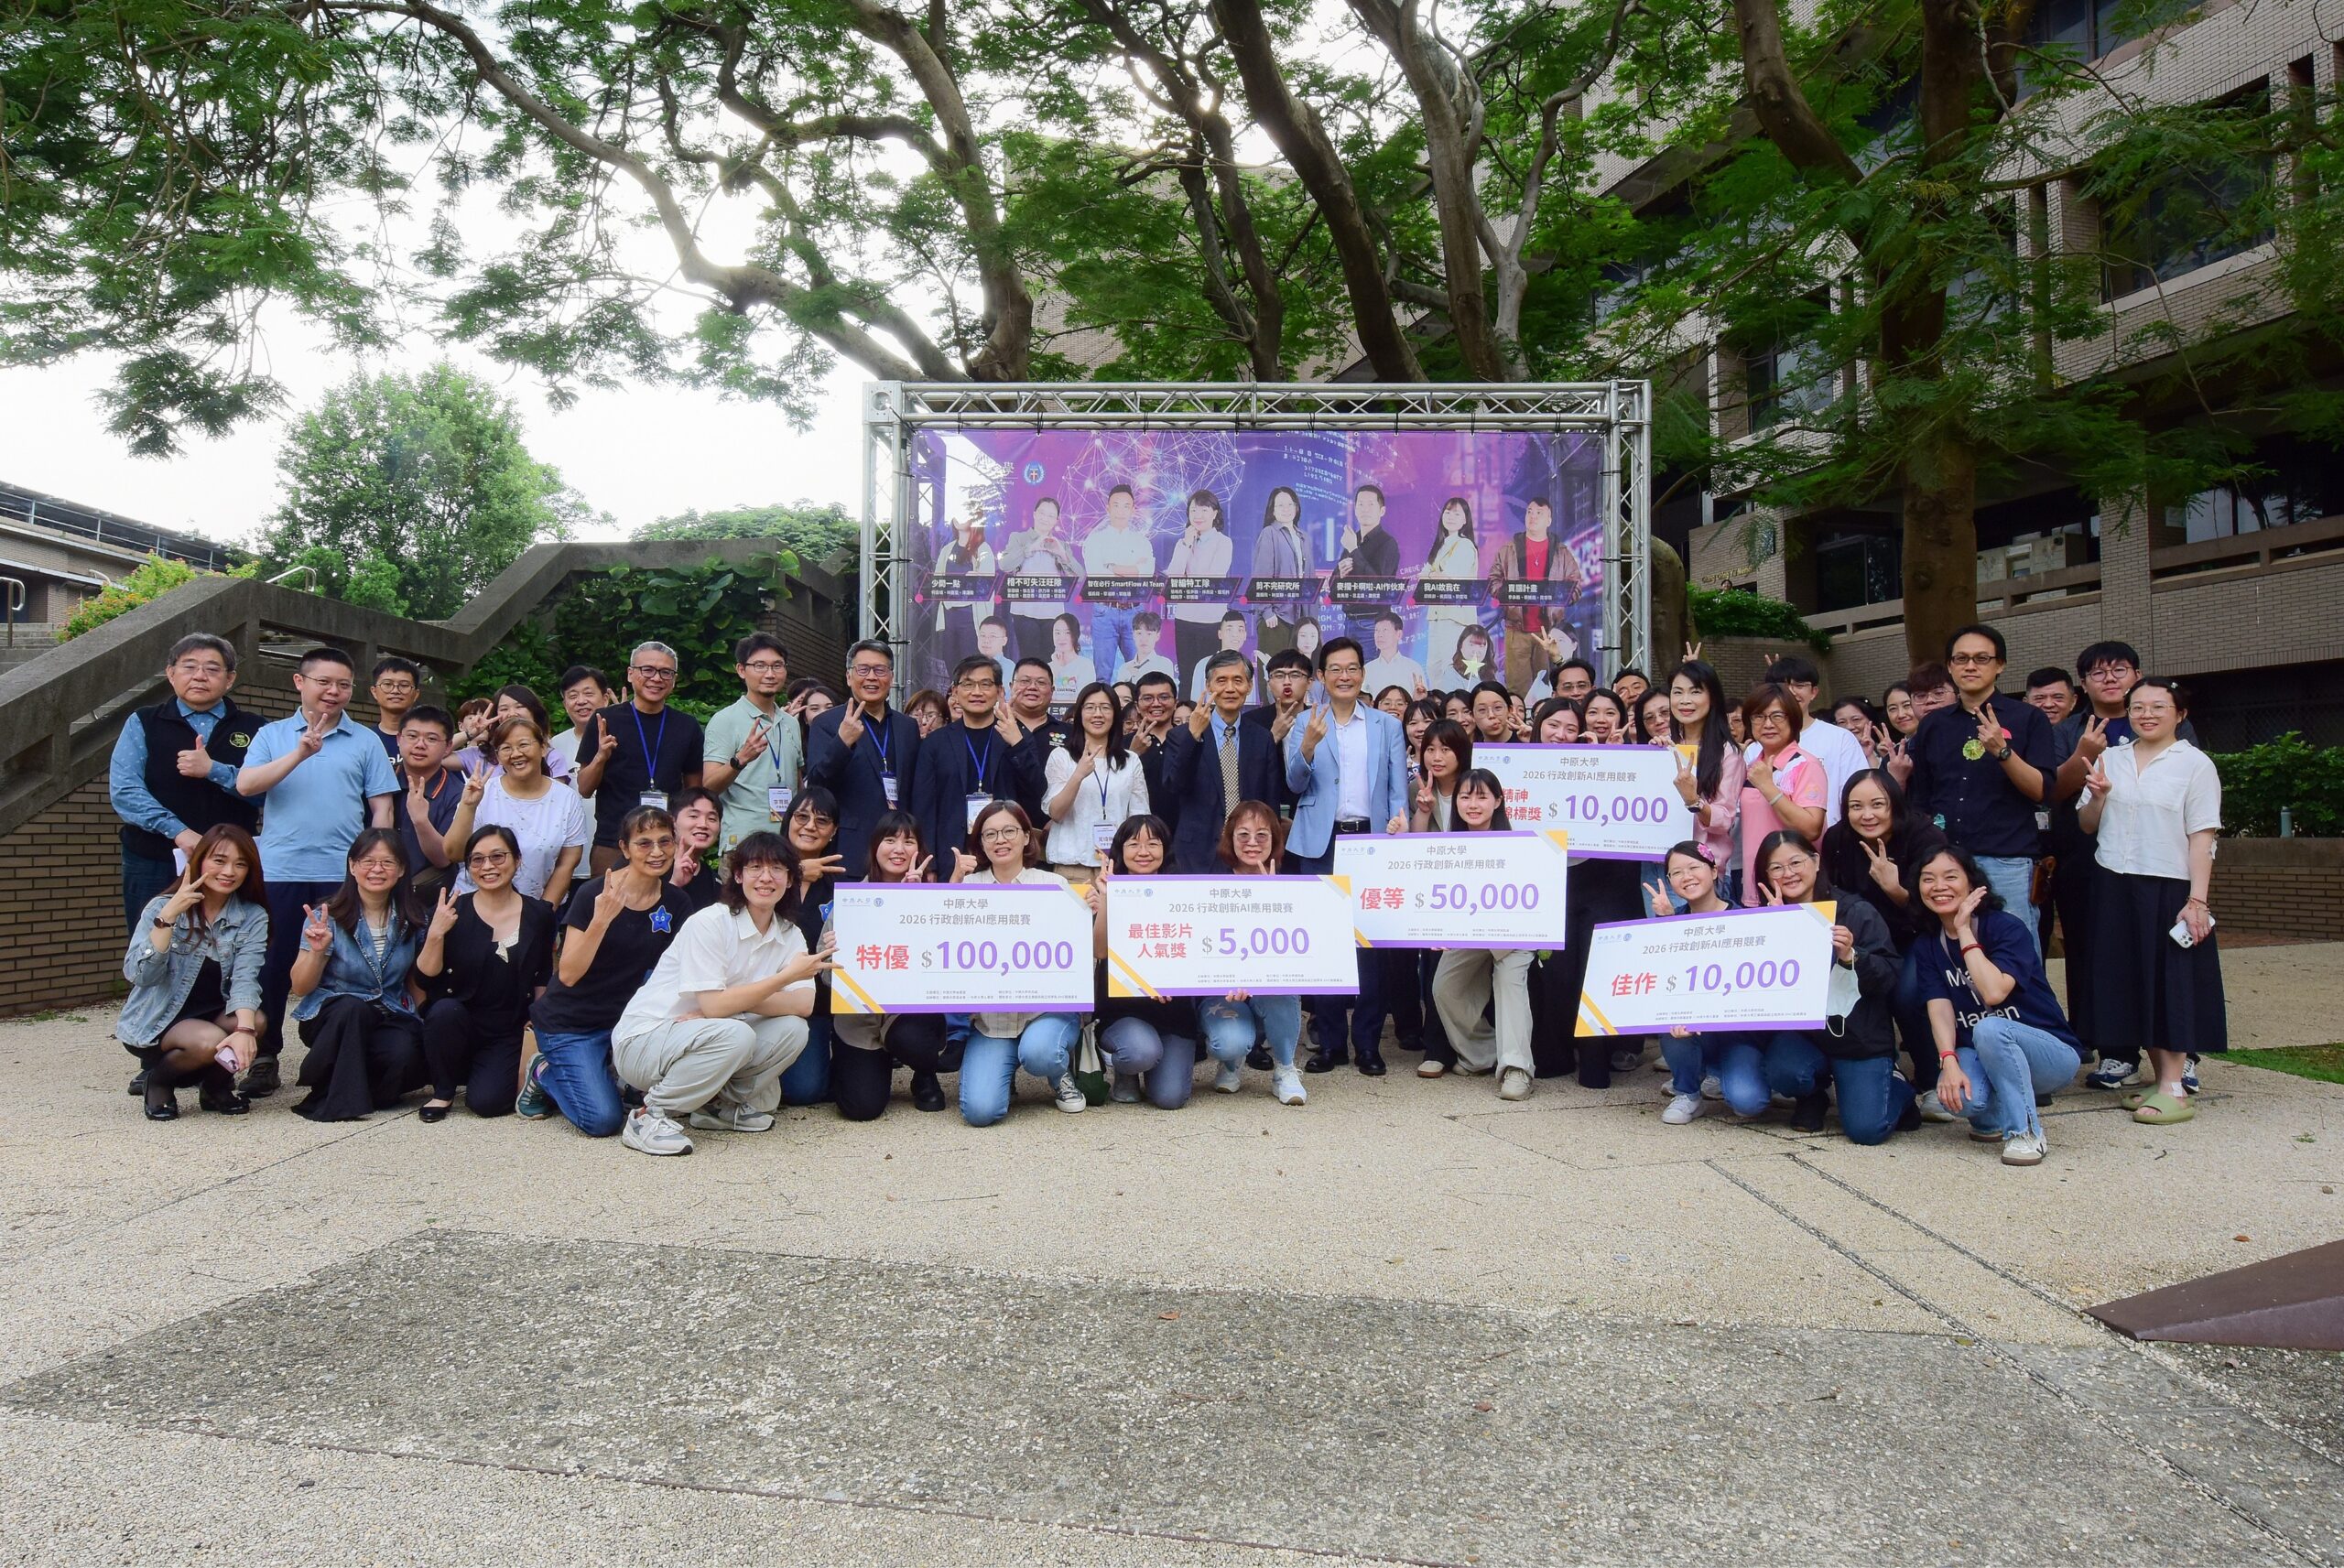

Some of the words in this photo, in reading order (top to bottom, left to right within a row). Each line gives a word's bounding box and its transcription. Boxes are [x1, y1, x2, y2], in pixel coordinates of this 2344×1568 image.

[1559, 757, 1599, 767] 中原大學
[1523, 771, 1545, 780] 2026
[1547, 771, 1637, 782] 行政創新AI應用競賽
[1427, 845, 1467, 855] 中原大學
[1388, 860, 1411, 870] 2026
[1414, 859, 1505, 870] 行政創新AI應用競賽
[1210, 888, 1253, 899] 中原大學
[1360, 887, 1405, 910] 優等
[943, 898, 989, 910] 中原大學
[1169, 903, 1194, 914] 2026
[1197, 903, 1293, 914] 行政創新AI應用競賽
[899, 914, 927, 925] 2026
[929, 914, 1031, 925] 行政創新AI應用競賽
[1128, 923, 1193, 939] 最佳影片
[1683, 925, 1726, 936] 中原大學
[1137, 943, 1187, 958] 人氣獎
[1642, 944, 1666, 955] 2026
[1669, 935, 1766, 954] 行政創新AI應用競賽
[856, 944, 910, 970] 特優
[1612, 972, 1657, 997] 佳作
